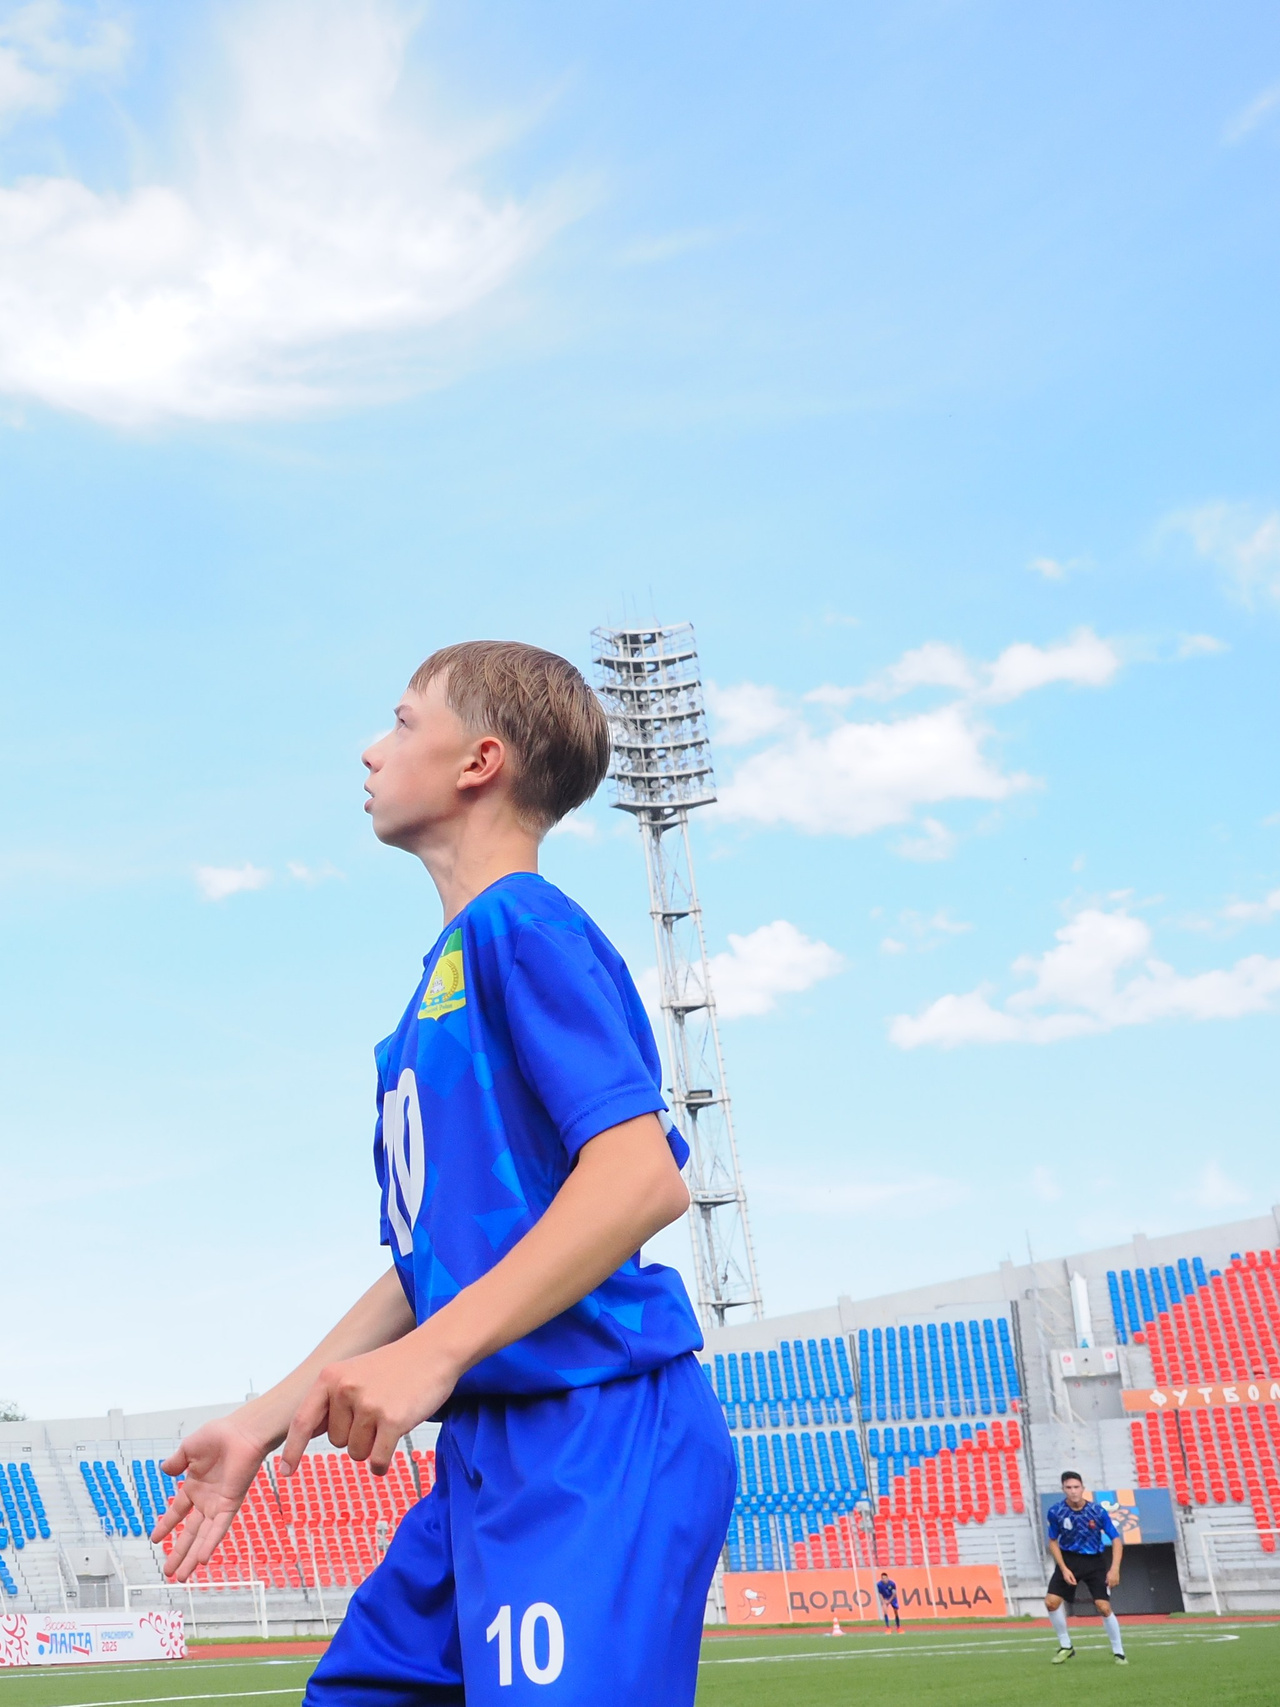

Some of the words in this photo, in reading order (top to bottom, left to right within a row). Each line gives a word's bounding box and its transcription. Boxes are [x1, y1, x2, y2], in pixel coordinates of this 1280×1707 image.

[788, 1589, 872, 1613] ДОДО
[902, 1585, 993, 1610] ИЦЦА
[49, 1632, 93, 1654] ЛАПТА
[101, 1641, 118, 1652] 2025
[486, 1602, 565, 1686] 10
